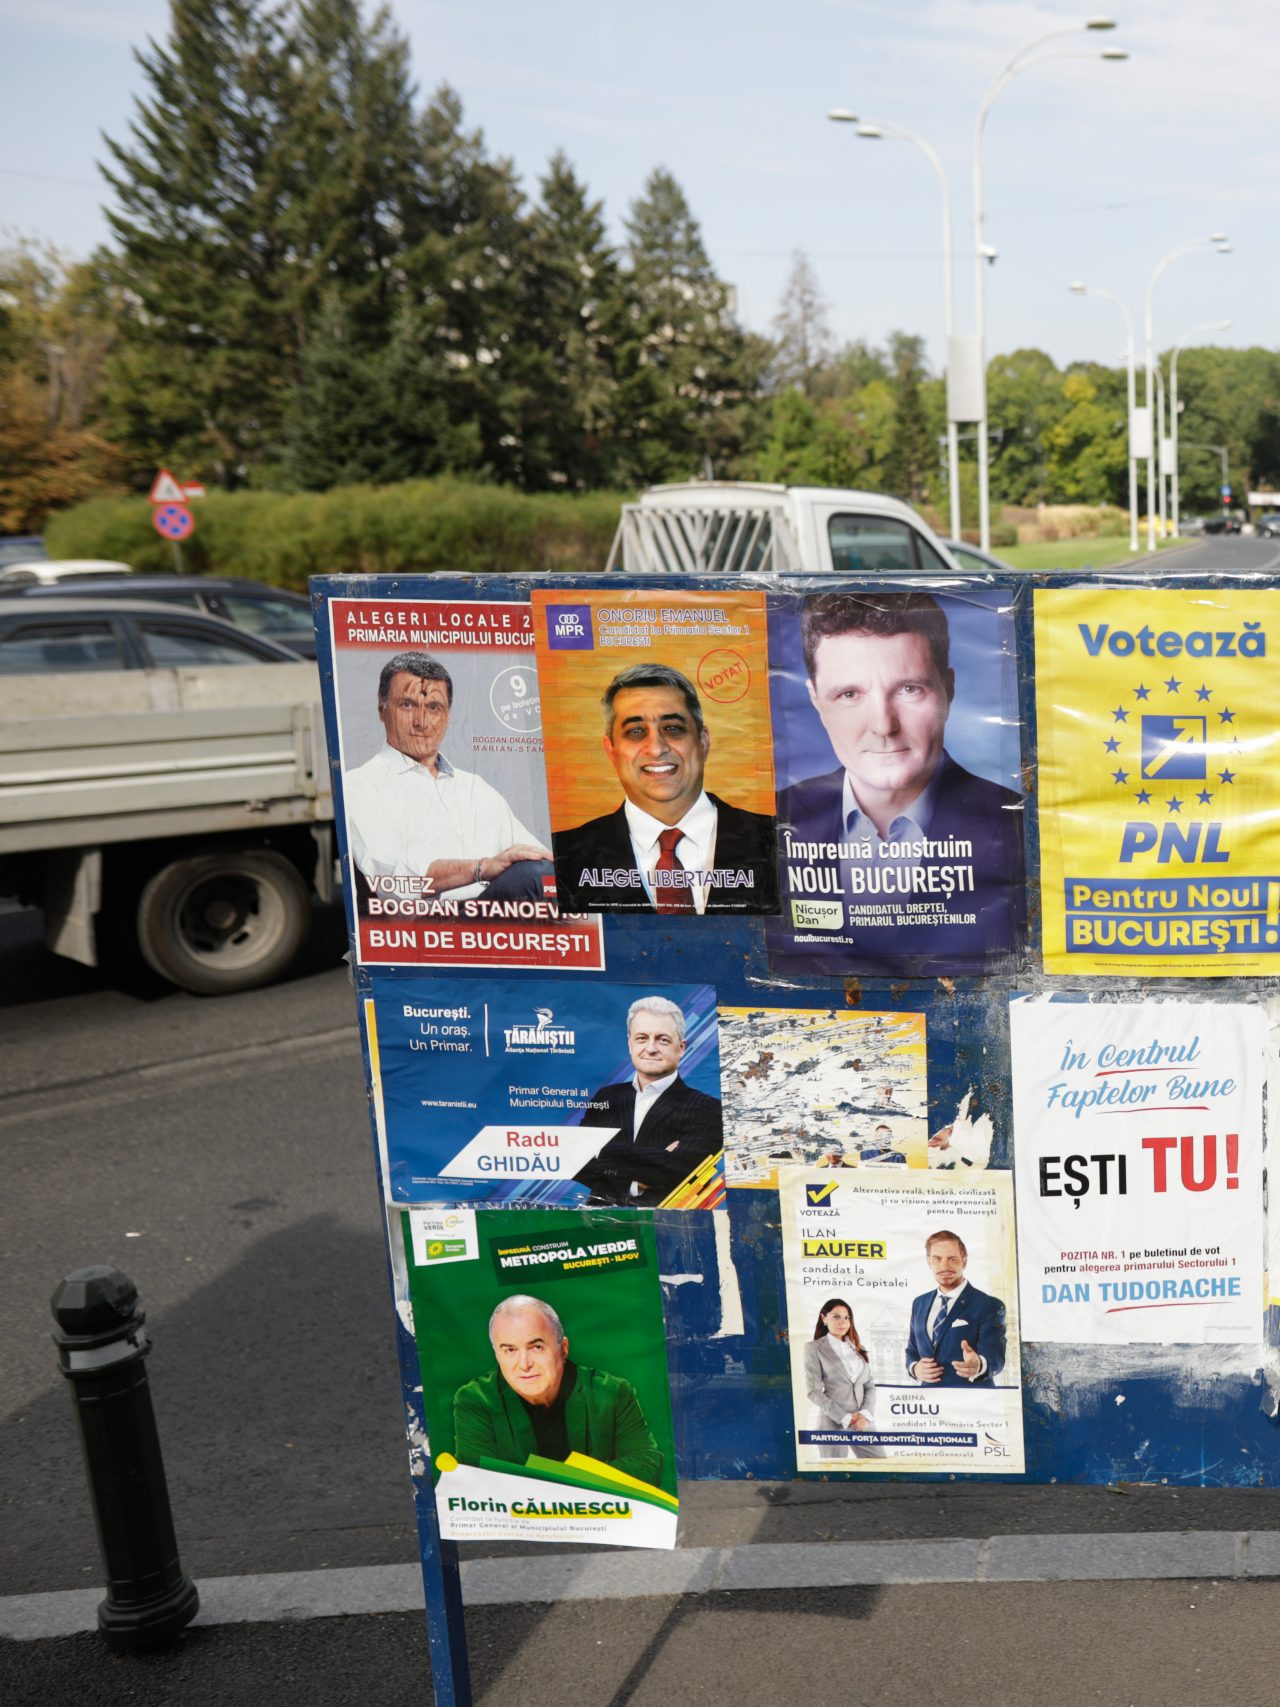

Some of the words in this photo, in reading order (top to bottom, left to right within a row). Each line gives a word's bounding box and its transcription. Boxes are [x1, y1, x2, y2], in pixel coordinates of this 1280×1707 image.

[347, 611, 427, 626] ALEGERI
[440, 613, 511, 628] LOCALE
[598, 609, 657, 623] ONORIU
[661, 609, 729, 623] EMANUEL
[348, 626, 407, 643] PRIMĂRIA
[411, 630, 491, 645] MUNICIPIULUI
[495, 632, 536, 646] BUCUR
[555, 625, 584, 636] MPR
[599, 624, 649, 635] Candidat
[708, 625, 741, 635] Sector
[1078, 621, 1266, 658] Votează
[704, 662, 743, 690] VOTAT
[510, 676, 527, 697] 9
[783, 830, 873, 865] Împreună
[878, 834, 973, 859] construim
[1119, 821, 1231, 864] PNL
[366, 875, 435, 894] VOTEZ
[579, 868, 641, 888] ALEGE
[647, 869, 755, 888] LIBERTATEA!
[787, 865, 845, 894] NOUL
[851, 865, 975, 899] BUCUREȘTI
[1072, 884, 1179, 908] Pentru
[1187, 882, 1260, 907] Noul
[368, 898, 458, 917] BOGDAN
[795, 903, 838, 918] Nicușor
[848, 903, 903, 915] CANDIDATUL
[906, 902, 948, 914] DREPTEI,
[796, 914, 819, 926] Dan
[849, 915, 895, 927] PRIMARUL
[896, 913, 977, 927] BUCUREȘTENILOR
[370, 930, 417, 948] BUN
[424, 931, 455, 949] DE
[461, 932, 590, 956] BUCUREȘTI
[794, 934, 854, 944] noulbucuresti.ro
[403, 1005, 471, 1021] București.
[421, 1023, 439, 1035] Un
[441, 1025, 471, 1038] oraș.
[409, 1039, 427, 1051] Un
[430, 1040, 472, 1052] Primar.
[1060, 1039, 1091, 1071] În
[1097, 1036, 1200, 1069] Centrul
[509, 1086, 539, 1095] Primar
[542, 1086, 577, 1097] General
[1047, 1078, 1157, 1118] Faptelor
[1166, 1075, 1237, 1100] Bune
[421, 1100, 477, 1109] www.taranistii.eu
[509, 1098, 564, 1109] Municipiului
[566, 1099, 610, 1110] București
[506, 1131, 559, 1147] Radu
[477, 1153, 560, 1172] GHIDĂU
[1039, 1154, 1127, 1210] EȘTI
[1142, 1134, 1239, 1193] TU!
[800, 1208, 840, 1217] VOTEAZĂ
[927, 1208, 954, 1216] pentru
[802, 1228, 836, 1238] ILAN
[500, 1248, 587, 1268] METROPOLA
[590, 1239, 637, 1256] VERDE
[532, 1241, 569, 1252] CONSTRUIM
[803, 1243, 884, 1258] LAUFER
[1060, 1250, 1098, 1262] POZIȚIA
[1101, 1250, 1118, 1260] NR.
[1129, 1251, 1141, 1261] pe
[1144, 1247, 1187, 1258] buletinul
[1190, 1247, 1201, 1256] de
[1204, 1246, 1220, 1256] vot
[563, 1257, 610, 1270] BUCUREȘTI
[615, 1252, 639, 1263] ILFOV
[1044, 1263, 1076, 1275] pentru
[1079, 1262, 1121, 1274] alegerea
[1123, 1260, 1175, 1272] primarului
[1178, 1258, 1228, 1269] Sectorului
[803, 1264, 852, 1275] candidat
[803, 1276, 853, 1287] Primăria
[856, 1277, 908, 1290] Capitalei
[1042, 1283, 1090, 1304] DAN
[1098, 1277, 1241, 1303] TUDORACHE
[891, 1403, 940, 1415] CIULU
[811, 1434, 851, 1442] PARTIDUL
[852, 1435, 879, 1444] FORȚA
[984, 1447, 1011, 1457] PSL
[448, 1497, 507, 1513] Florin
[511, 1498, 630, 1516] CĂLINESCU
